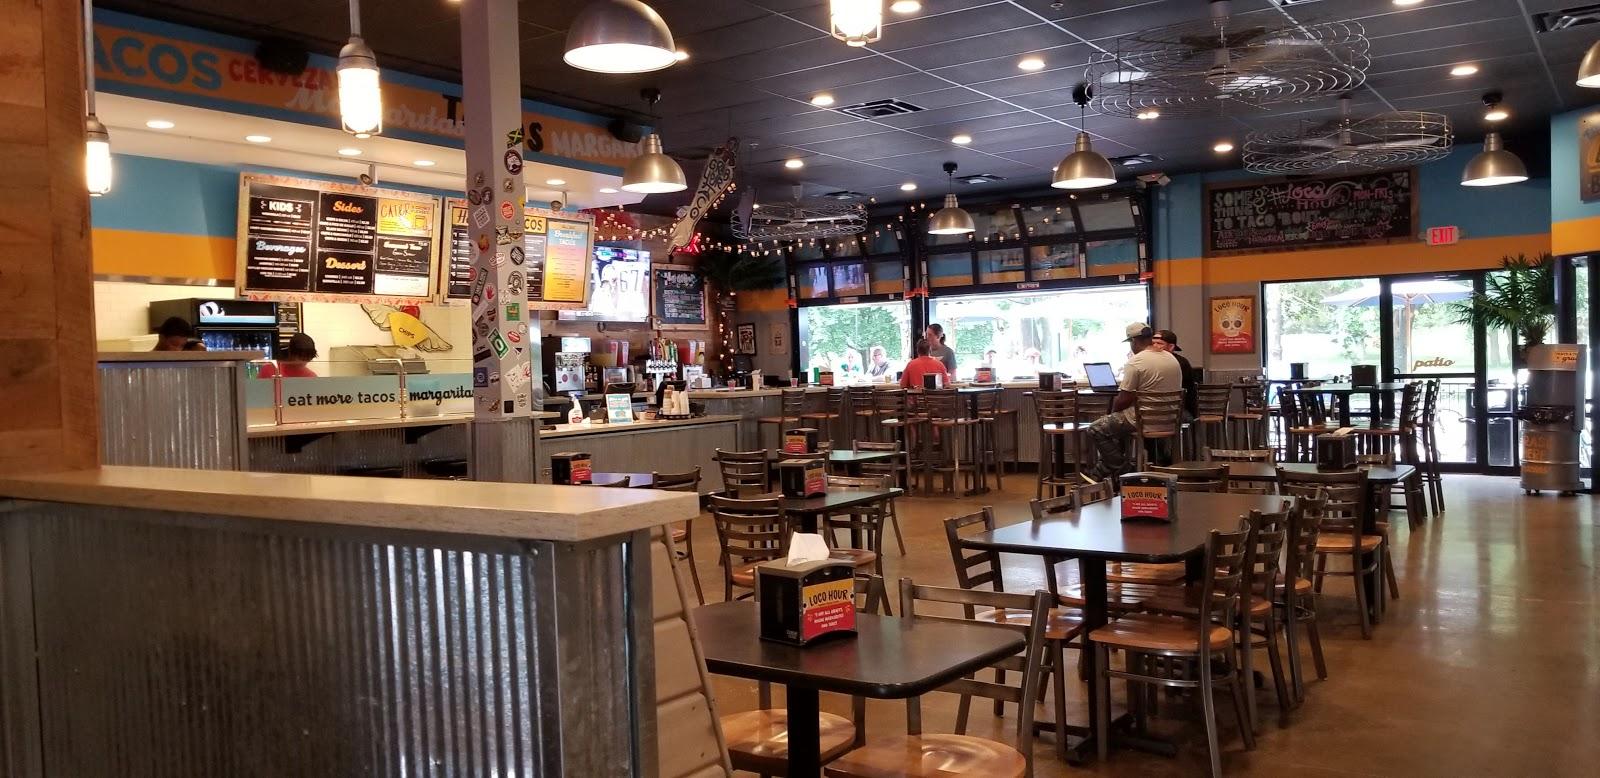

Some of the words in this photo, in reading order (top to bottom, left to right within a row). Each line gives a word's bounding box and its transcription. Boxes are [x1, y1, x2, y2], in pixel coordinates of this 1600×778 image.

[269, 200, 294, 213] KIDS
[332, 200, 364, 213] Sides
[525, 217, 543, 231] COS
[1432, 227, 1454, 245] EXIT
[1214, 300, 1230, 312] LOCO
[398, 327, 415, 339] CHIPS
[1413, 356, 1455, 371] patio
[288, 394, 313, 406] eat
[316, 392, 354, 405] more
[358, 391, 396, 403] tacos
[1127, 491, 1143, 499] LOCO
[809, 591, 827, 606] LOCO
[828, 589, 848, 601] HOUR
